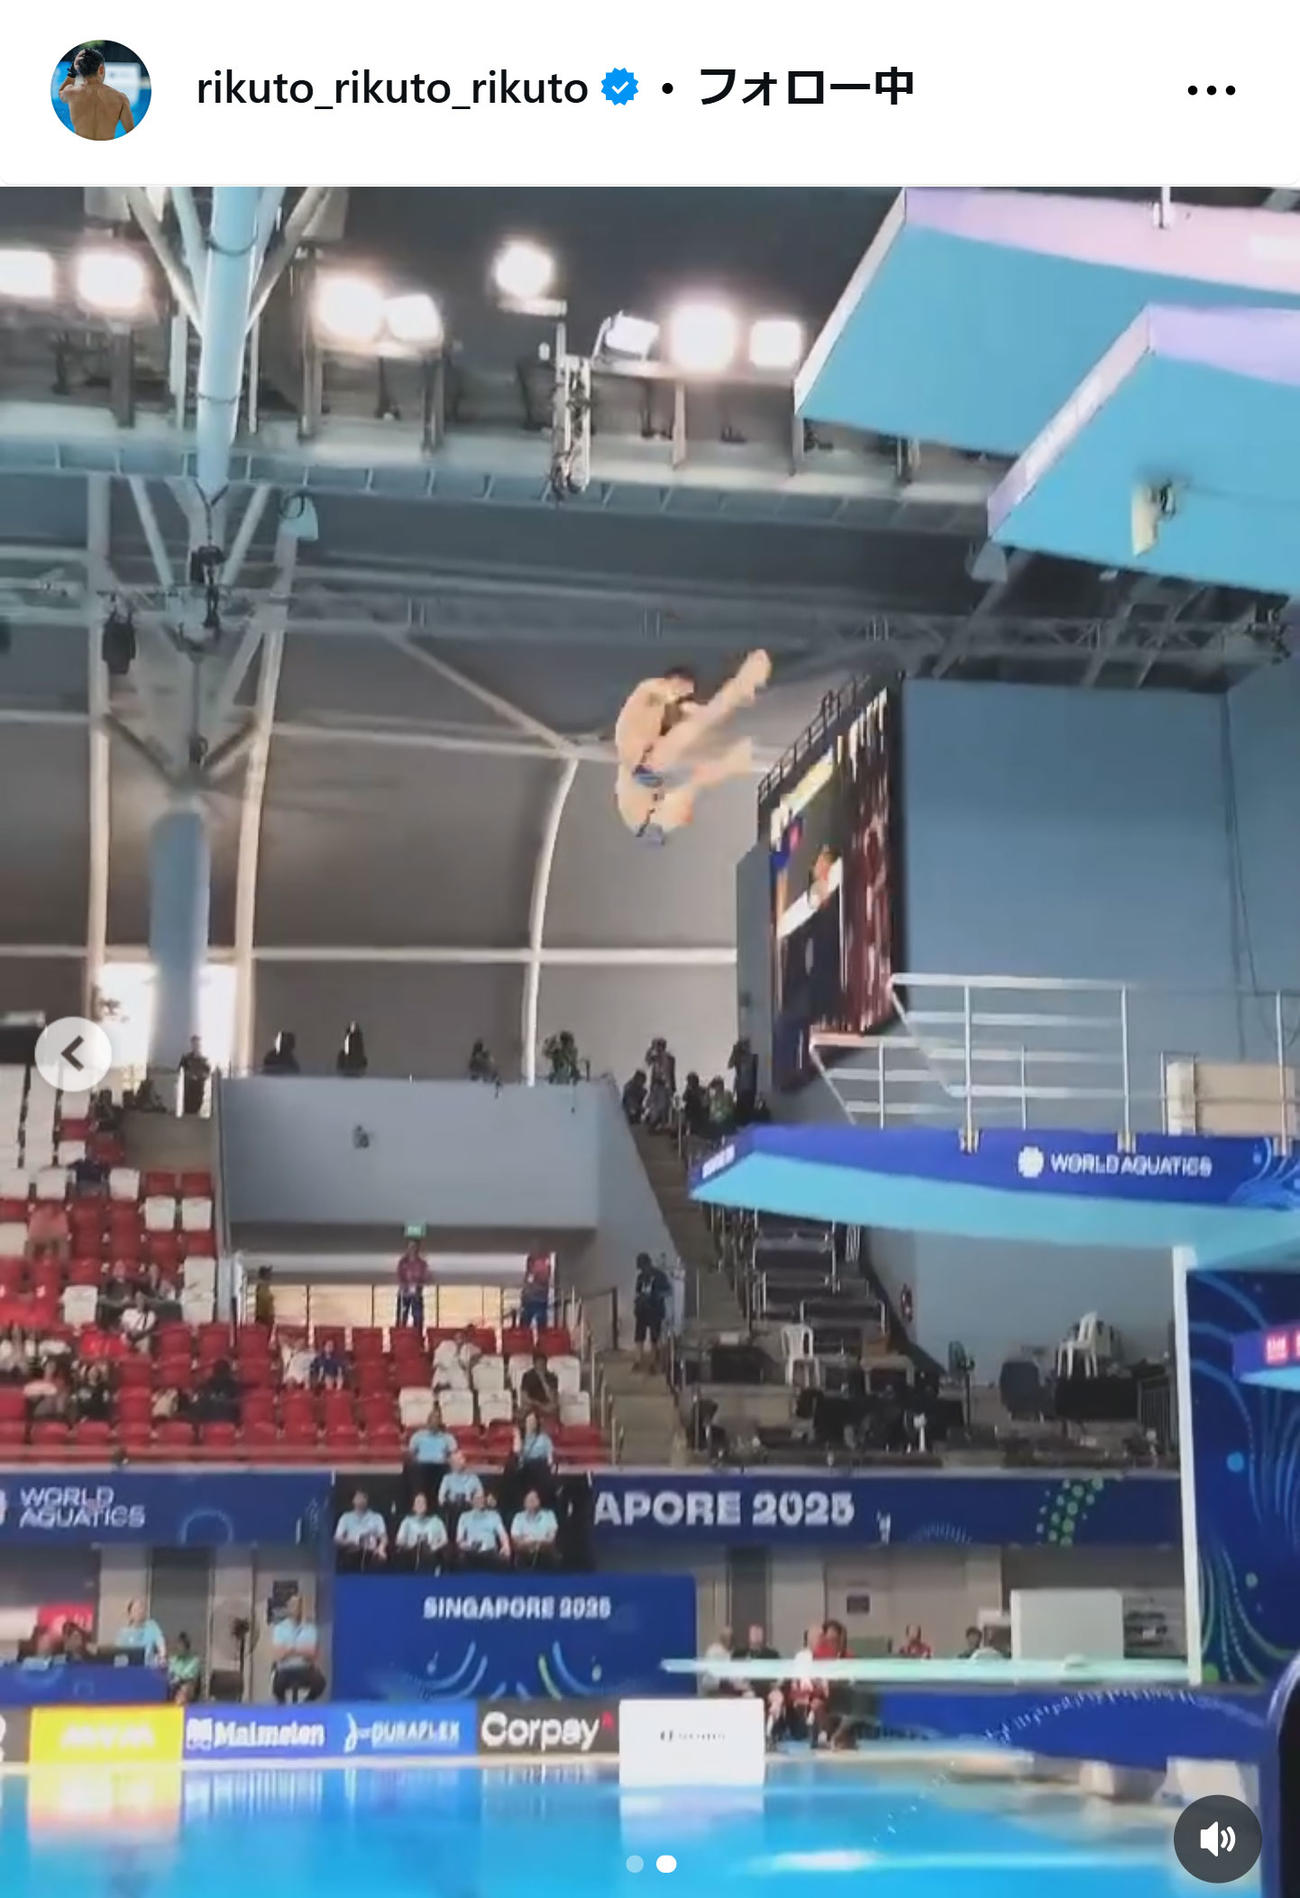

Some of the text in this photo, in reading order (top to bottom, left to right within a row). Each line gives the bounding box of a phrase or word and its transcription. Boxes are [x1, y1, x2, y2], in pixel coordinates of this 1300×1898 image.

[1050, 1153, 1213, 1178] WORLD AQUATICS
[20, 1486, 114, 1507] WORLD
[752, 1491, 855, 1525] 2025
[19, 1505, 146, 1528] AQUATICS
[423, 1595, 555, 1620] SINGAPORE
[480, 1711, 600, 1751] Corpay
